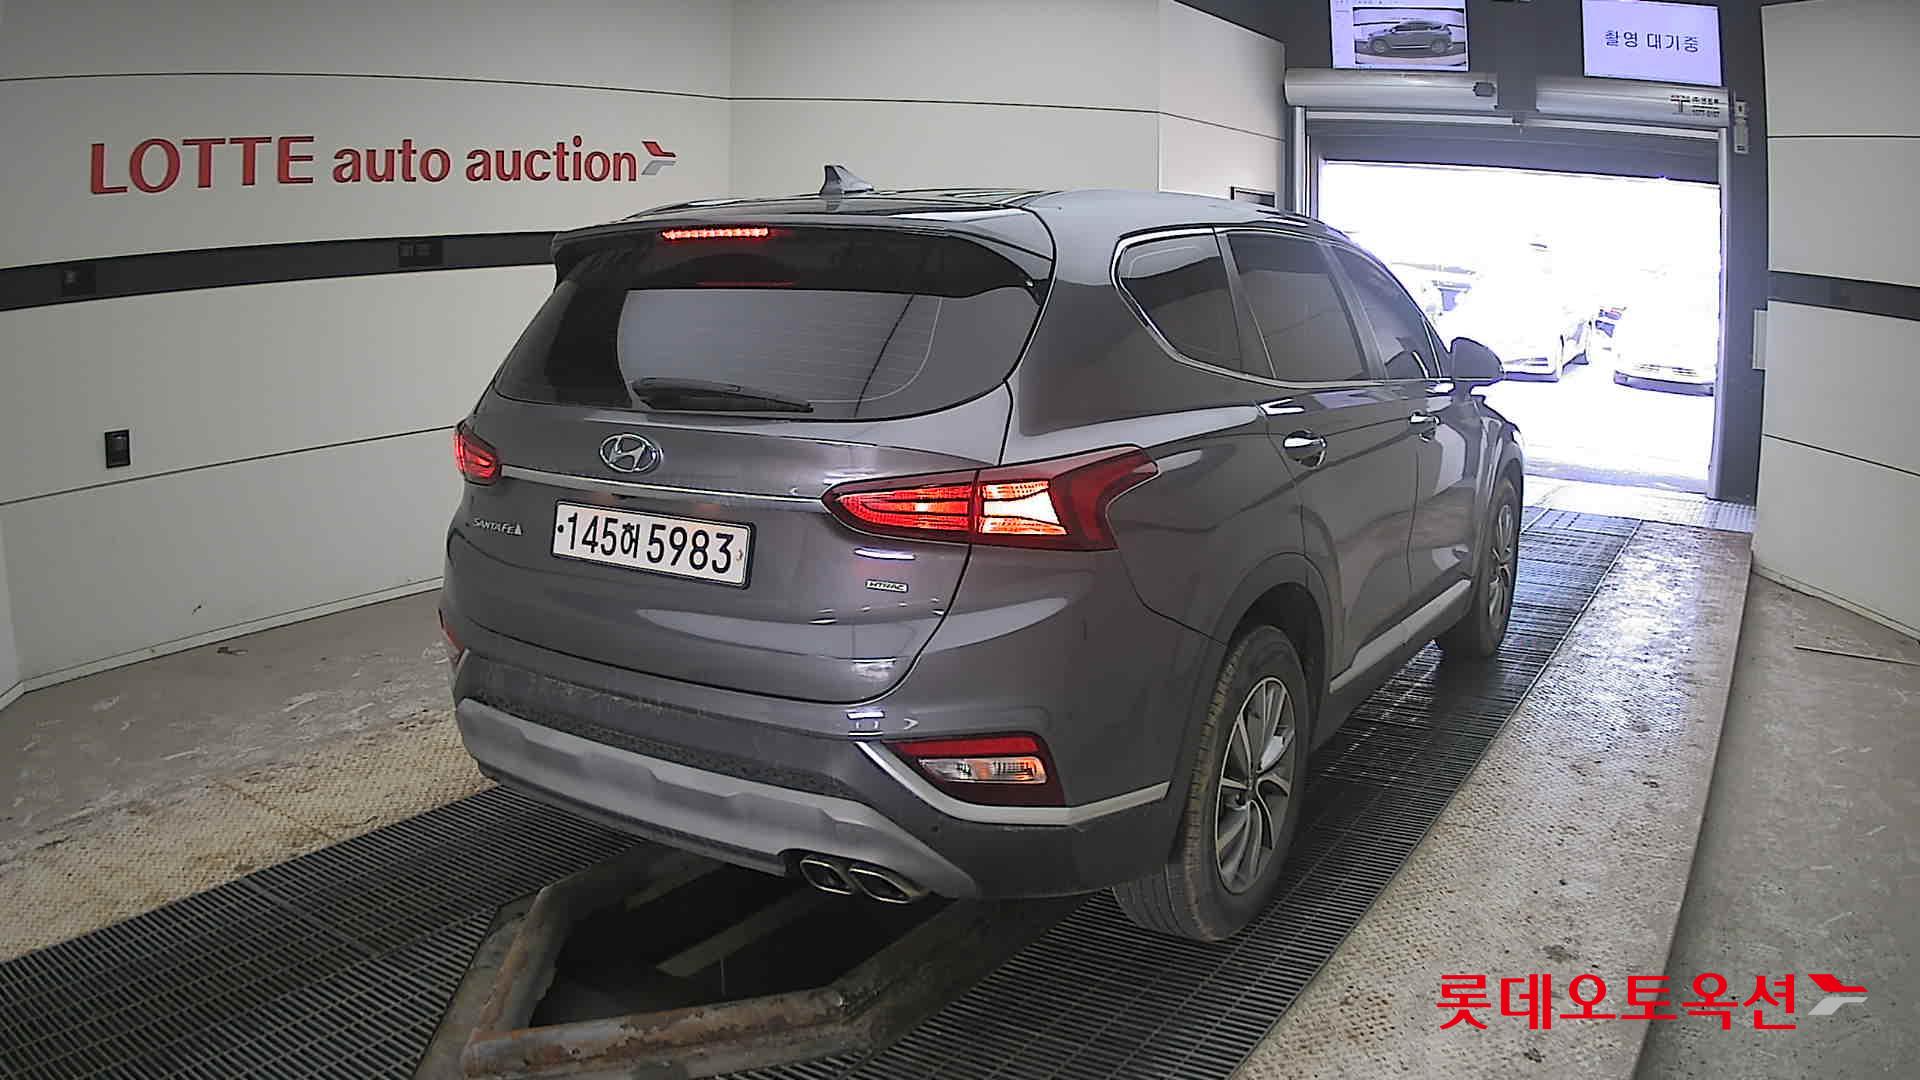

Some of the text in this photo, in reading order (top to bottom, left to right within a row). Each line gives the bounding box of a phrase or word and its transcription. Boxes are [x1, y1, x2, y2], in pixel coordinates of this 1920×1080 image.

[1646, 33, 1699, 53] 대기중
[90, 135, 638, 195] LOTTE auto auction
